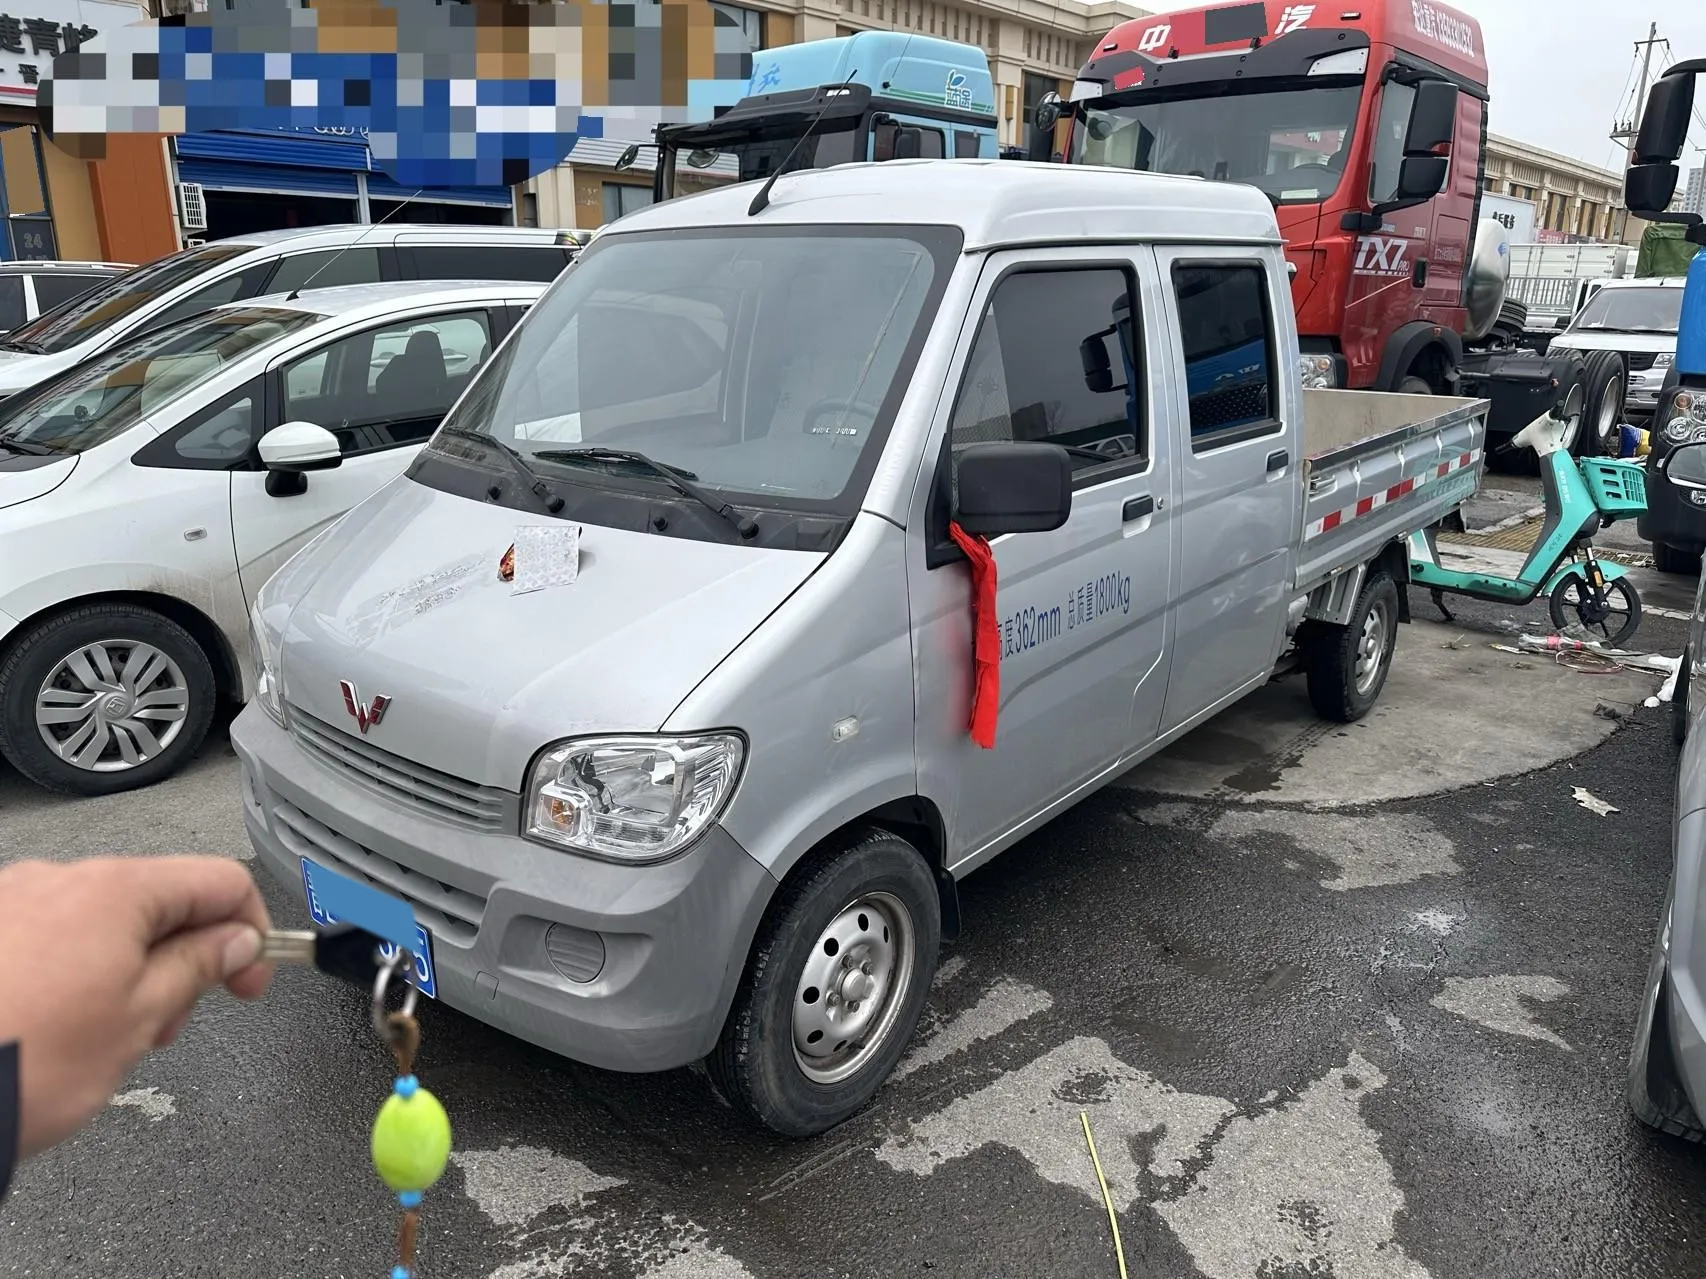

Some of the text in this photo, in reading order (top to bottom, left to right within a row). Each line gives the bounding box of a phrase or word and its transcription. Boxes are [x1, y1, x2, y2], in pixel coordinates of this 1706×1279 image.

[1138, 5, 1316, 51] 中 汽
[1354, 235, 1408, 270] TX7
[1068, 571, 1131, 630] 总质量1800kg
